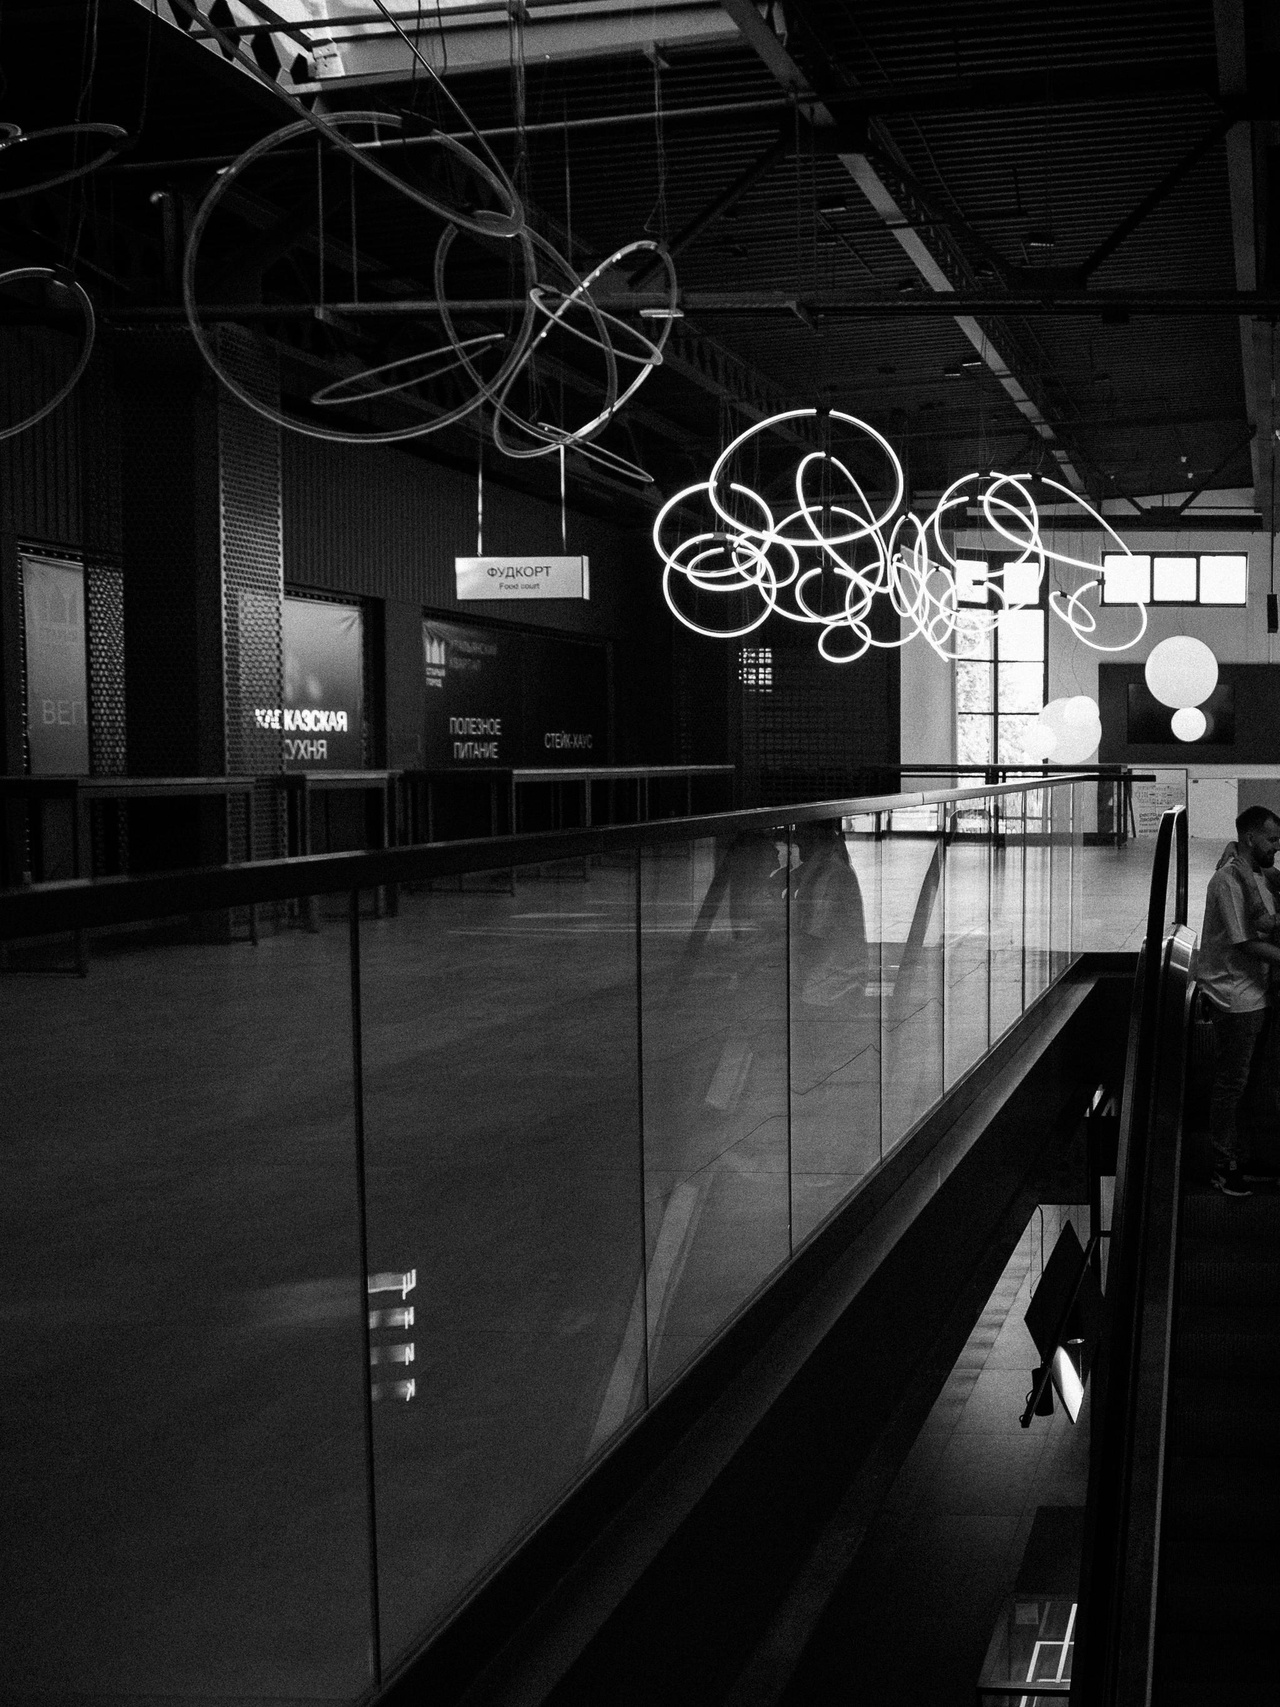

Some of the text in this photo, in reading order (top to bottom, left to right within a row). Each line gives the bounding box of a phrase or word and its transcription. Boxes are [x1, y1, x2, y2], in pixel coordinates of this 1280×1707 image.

[487, 566, 552, 579] ФУДКОРТ
[42, 699, 87, 725] ВЕГ
[450, 717, 502, 735] ПОЛЕЗНОЕ
[544, 730, 594, 749] СТЕЙК-ХАУС
[284, 738, 328, 760] УХНЯ
[453, 742, 499, 759] ПИТАНИЕ
